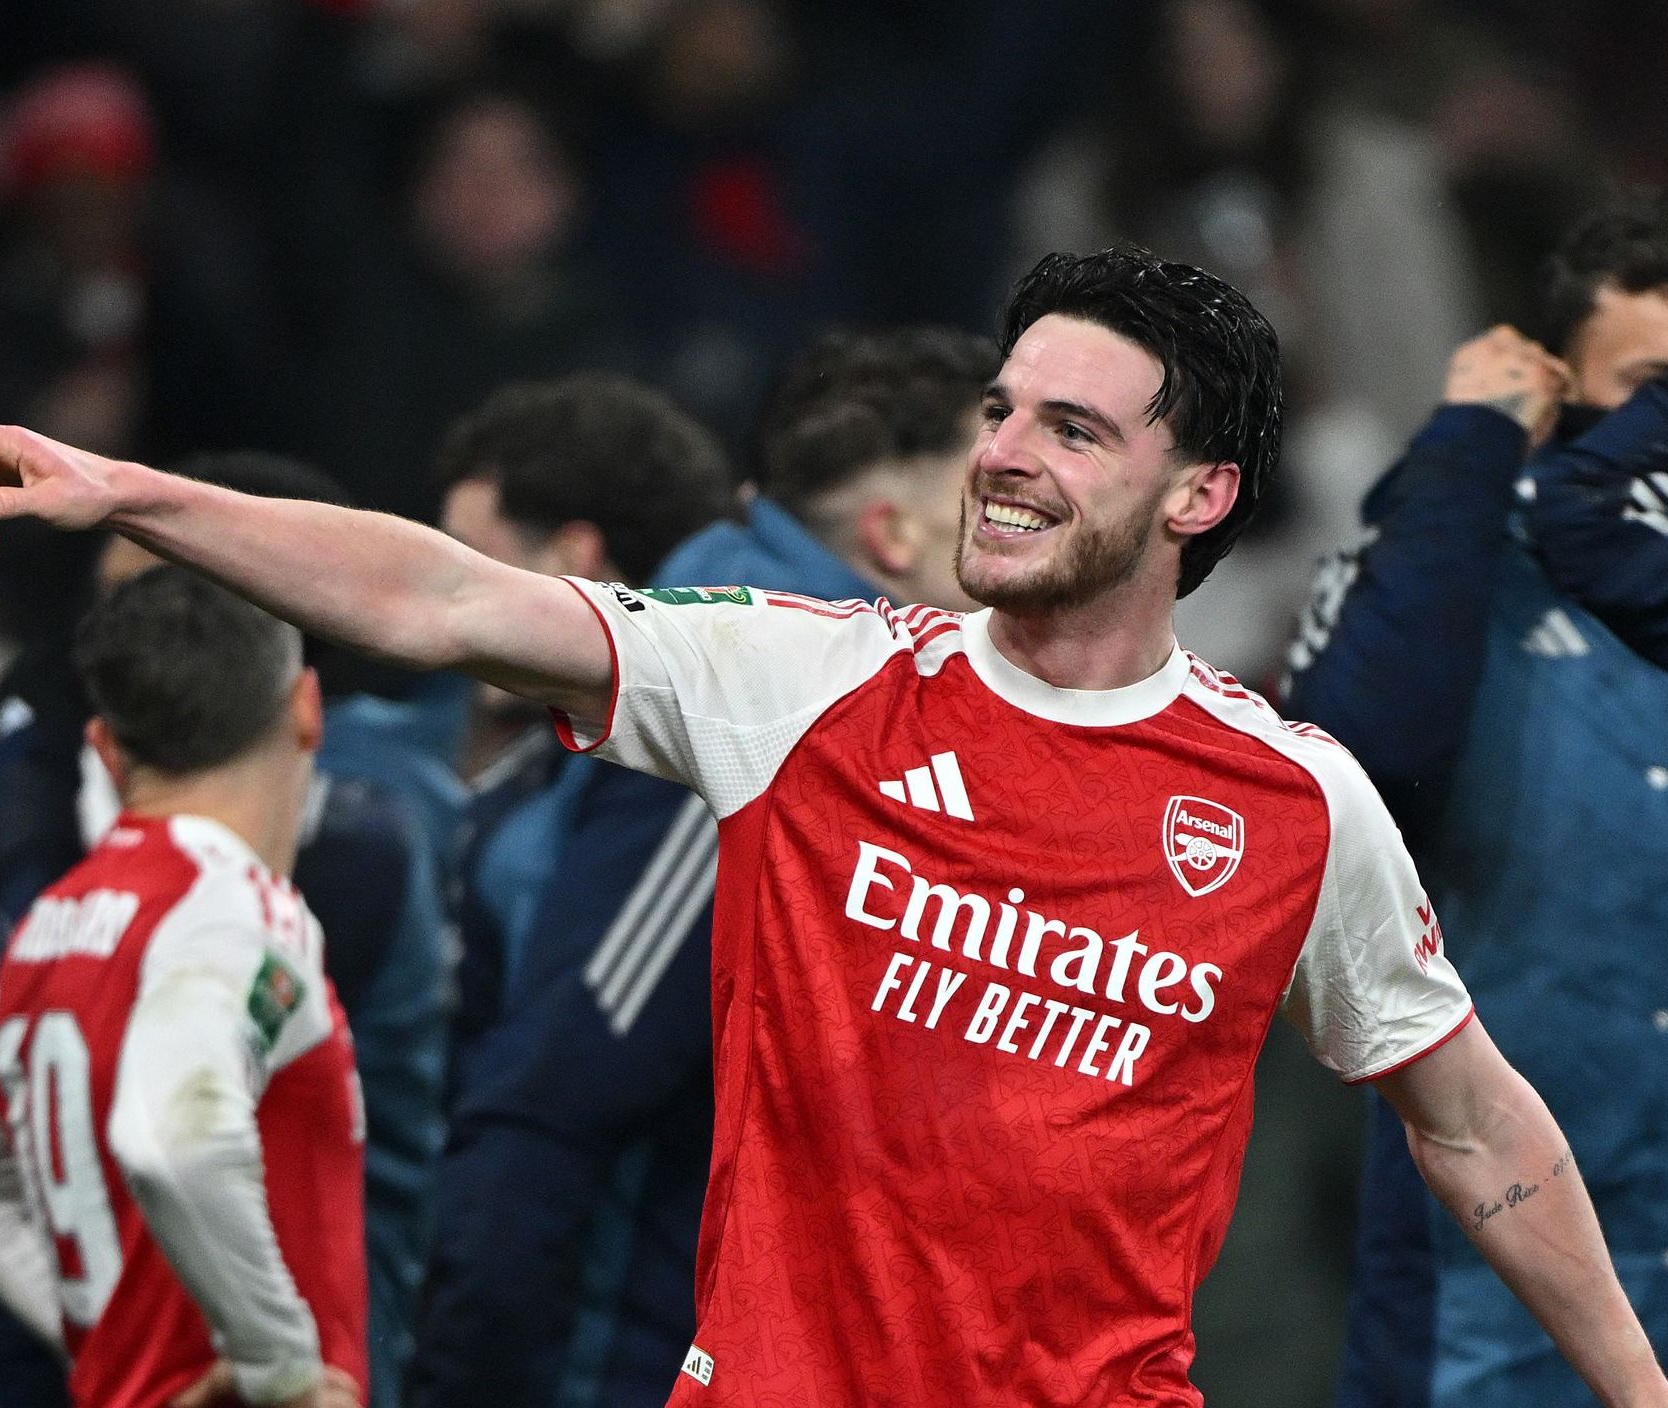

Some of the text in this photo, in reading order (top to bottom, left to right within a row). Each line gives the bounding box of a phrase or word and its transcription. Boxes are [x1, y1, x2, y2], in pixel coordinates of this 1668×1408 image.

[1175, 809, 1233, 840] Arsenal
[844, 839, 1224, 1024] Emirates
[870, 951, 1152, 1087] FLY BETTER
